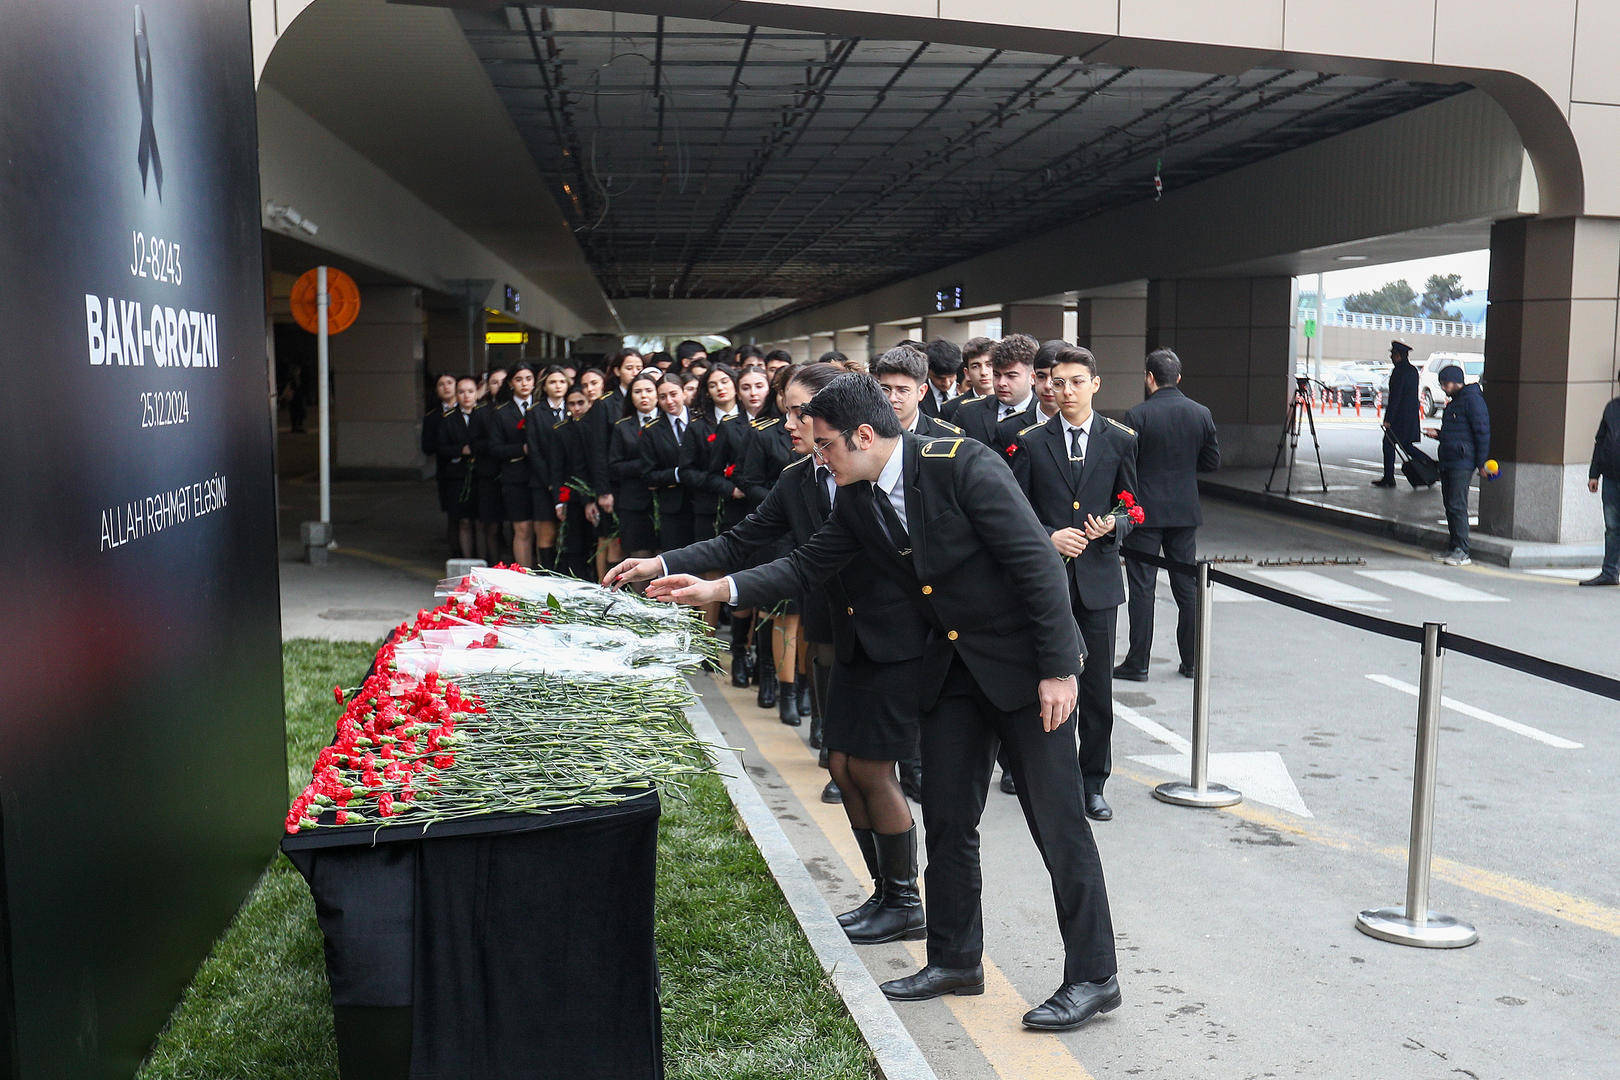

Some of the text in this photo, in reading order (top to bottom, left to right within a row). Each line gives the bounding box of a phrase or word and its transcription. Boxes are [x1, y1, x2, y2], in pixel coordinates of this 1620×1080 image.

[130, 230, 183, 286] J2-8243
[85, 293, 219, 368] BAKI-QROZNI
[140, 390, 190, 428] 25.12.2024
[100, 499, 145, 553] ALLAH
[146, 485, 191, 535] RƏHMƏT
